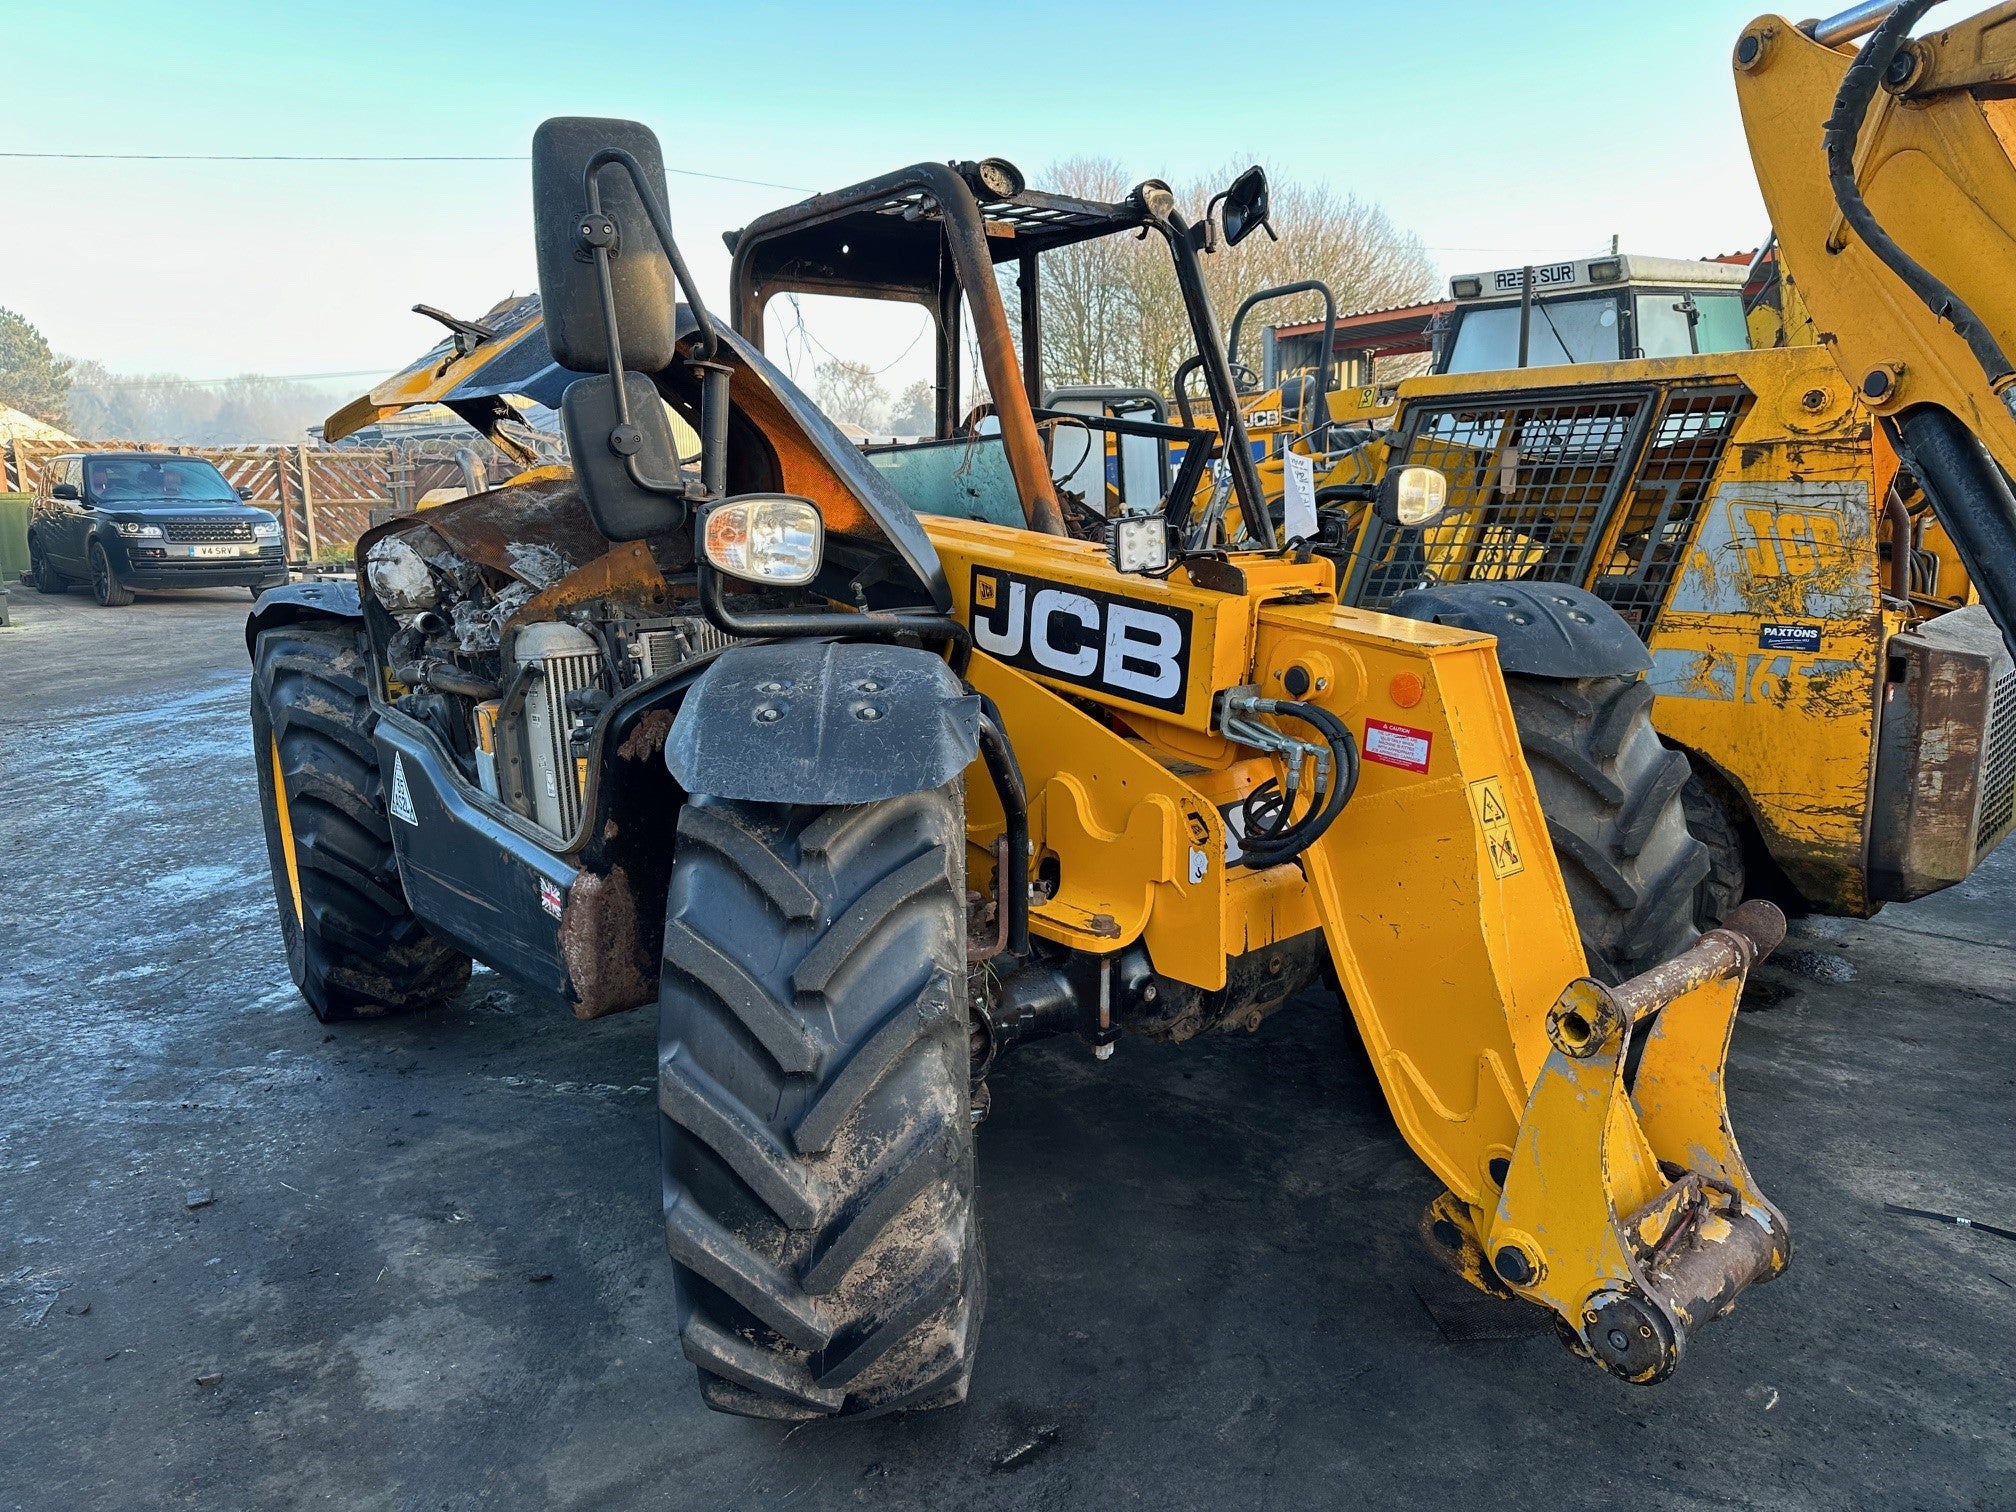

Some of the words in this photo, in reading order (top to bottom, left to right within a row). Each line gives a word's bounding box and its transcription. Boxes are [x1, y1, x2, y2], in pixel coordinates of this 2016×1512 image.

[1540, 265, 1571, 283] SUR
[1243, 410, 1279, 427] JCB
[201, 547, 212, 555] V4
[215, 547, 232, 555] SRV
[974, 581, 1182, 699] JCB
[1764, 627, 1818, 639] PAXTONS
[1388, 725, 1410, 734] CAUTION
